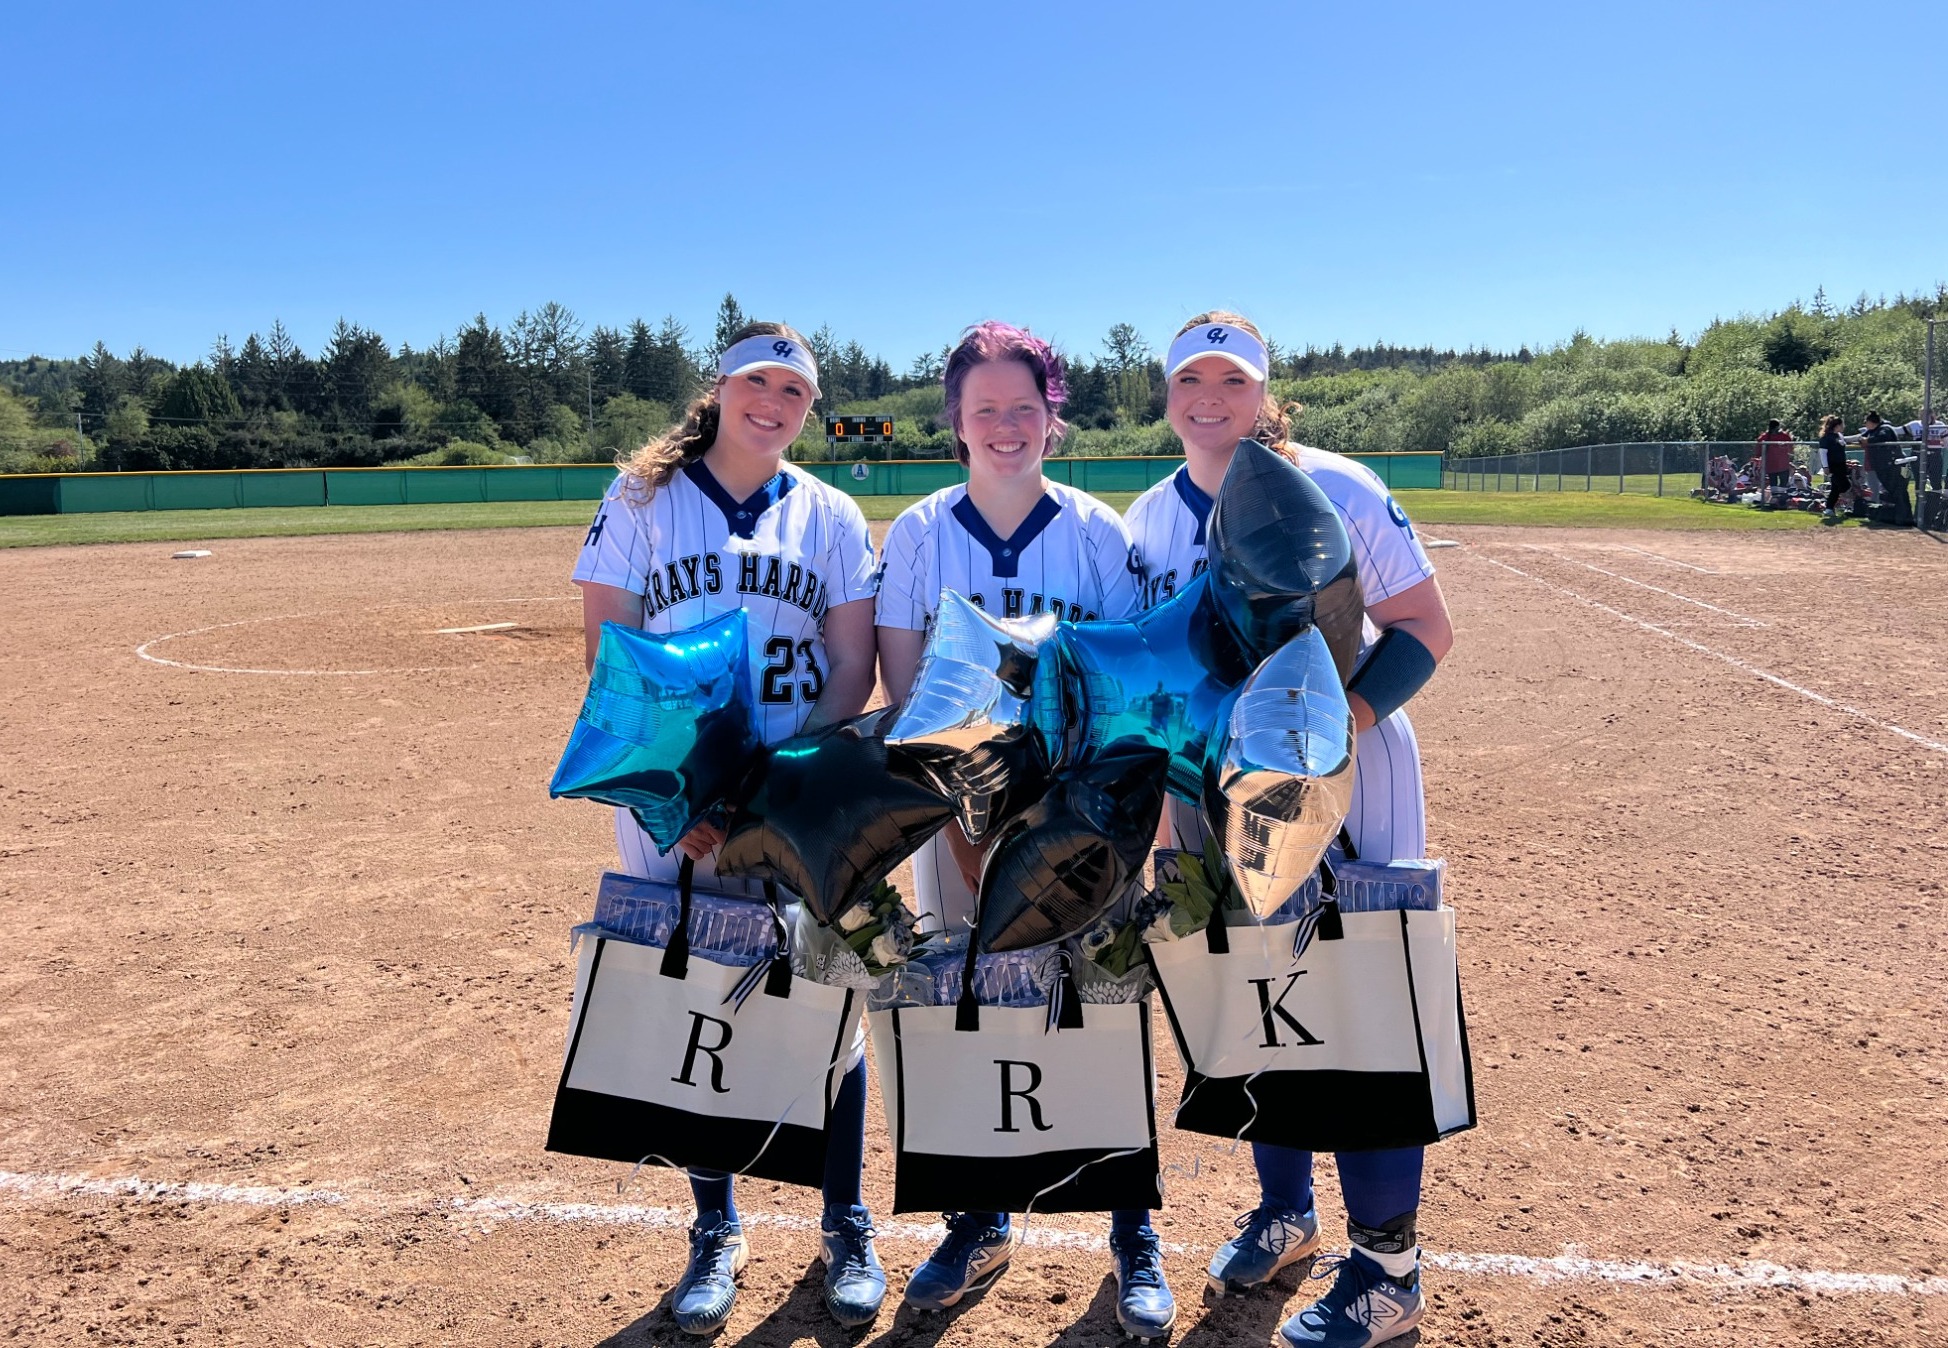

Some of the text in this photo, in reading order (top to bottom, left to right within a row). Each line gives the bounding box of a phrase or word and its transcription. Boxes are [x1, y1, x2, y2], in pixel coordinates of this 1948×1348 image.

[772, 341, 793, 358] GH
[1207, 328, 1228, 344] GH
[836, 423, 843, 436] 0
[883, 422, 891, 435] 0
[736, 550, 828, 631] HARBO
[759, 635, 824, 705] 23
[1337, 879, 1426, 911] HOKERS
[1248, 970, 1325, 1048] K
[671, 1010, 733, 1094] R
[993, 1059, 1053, 1133] R
